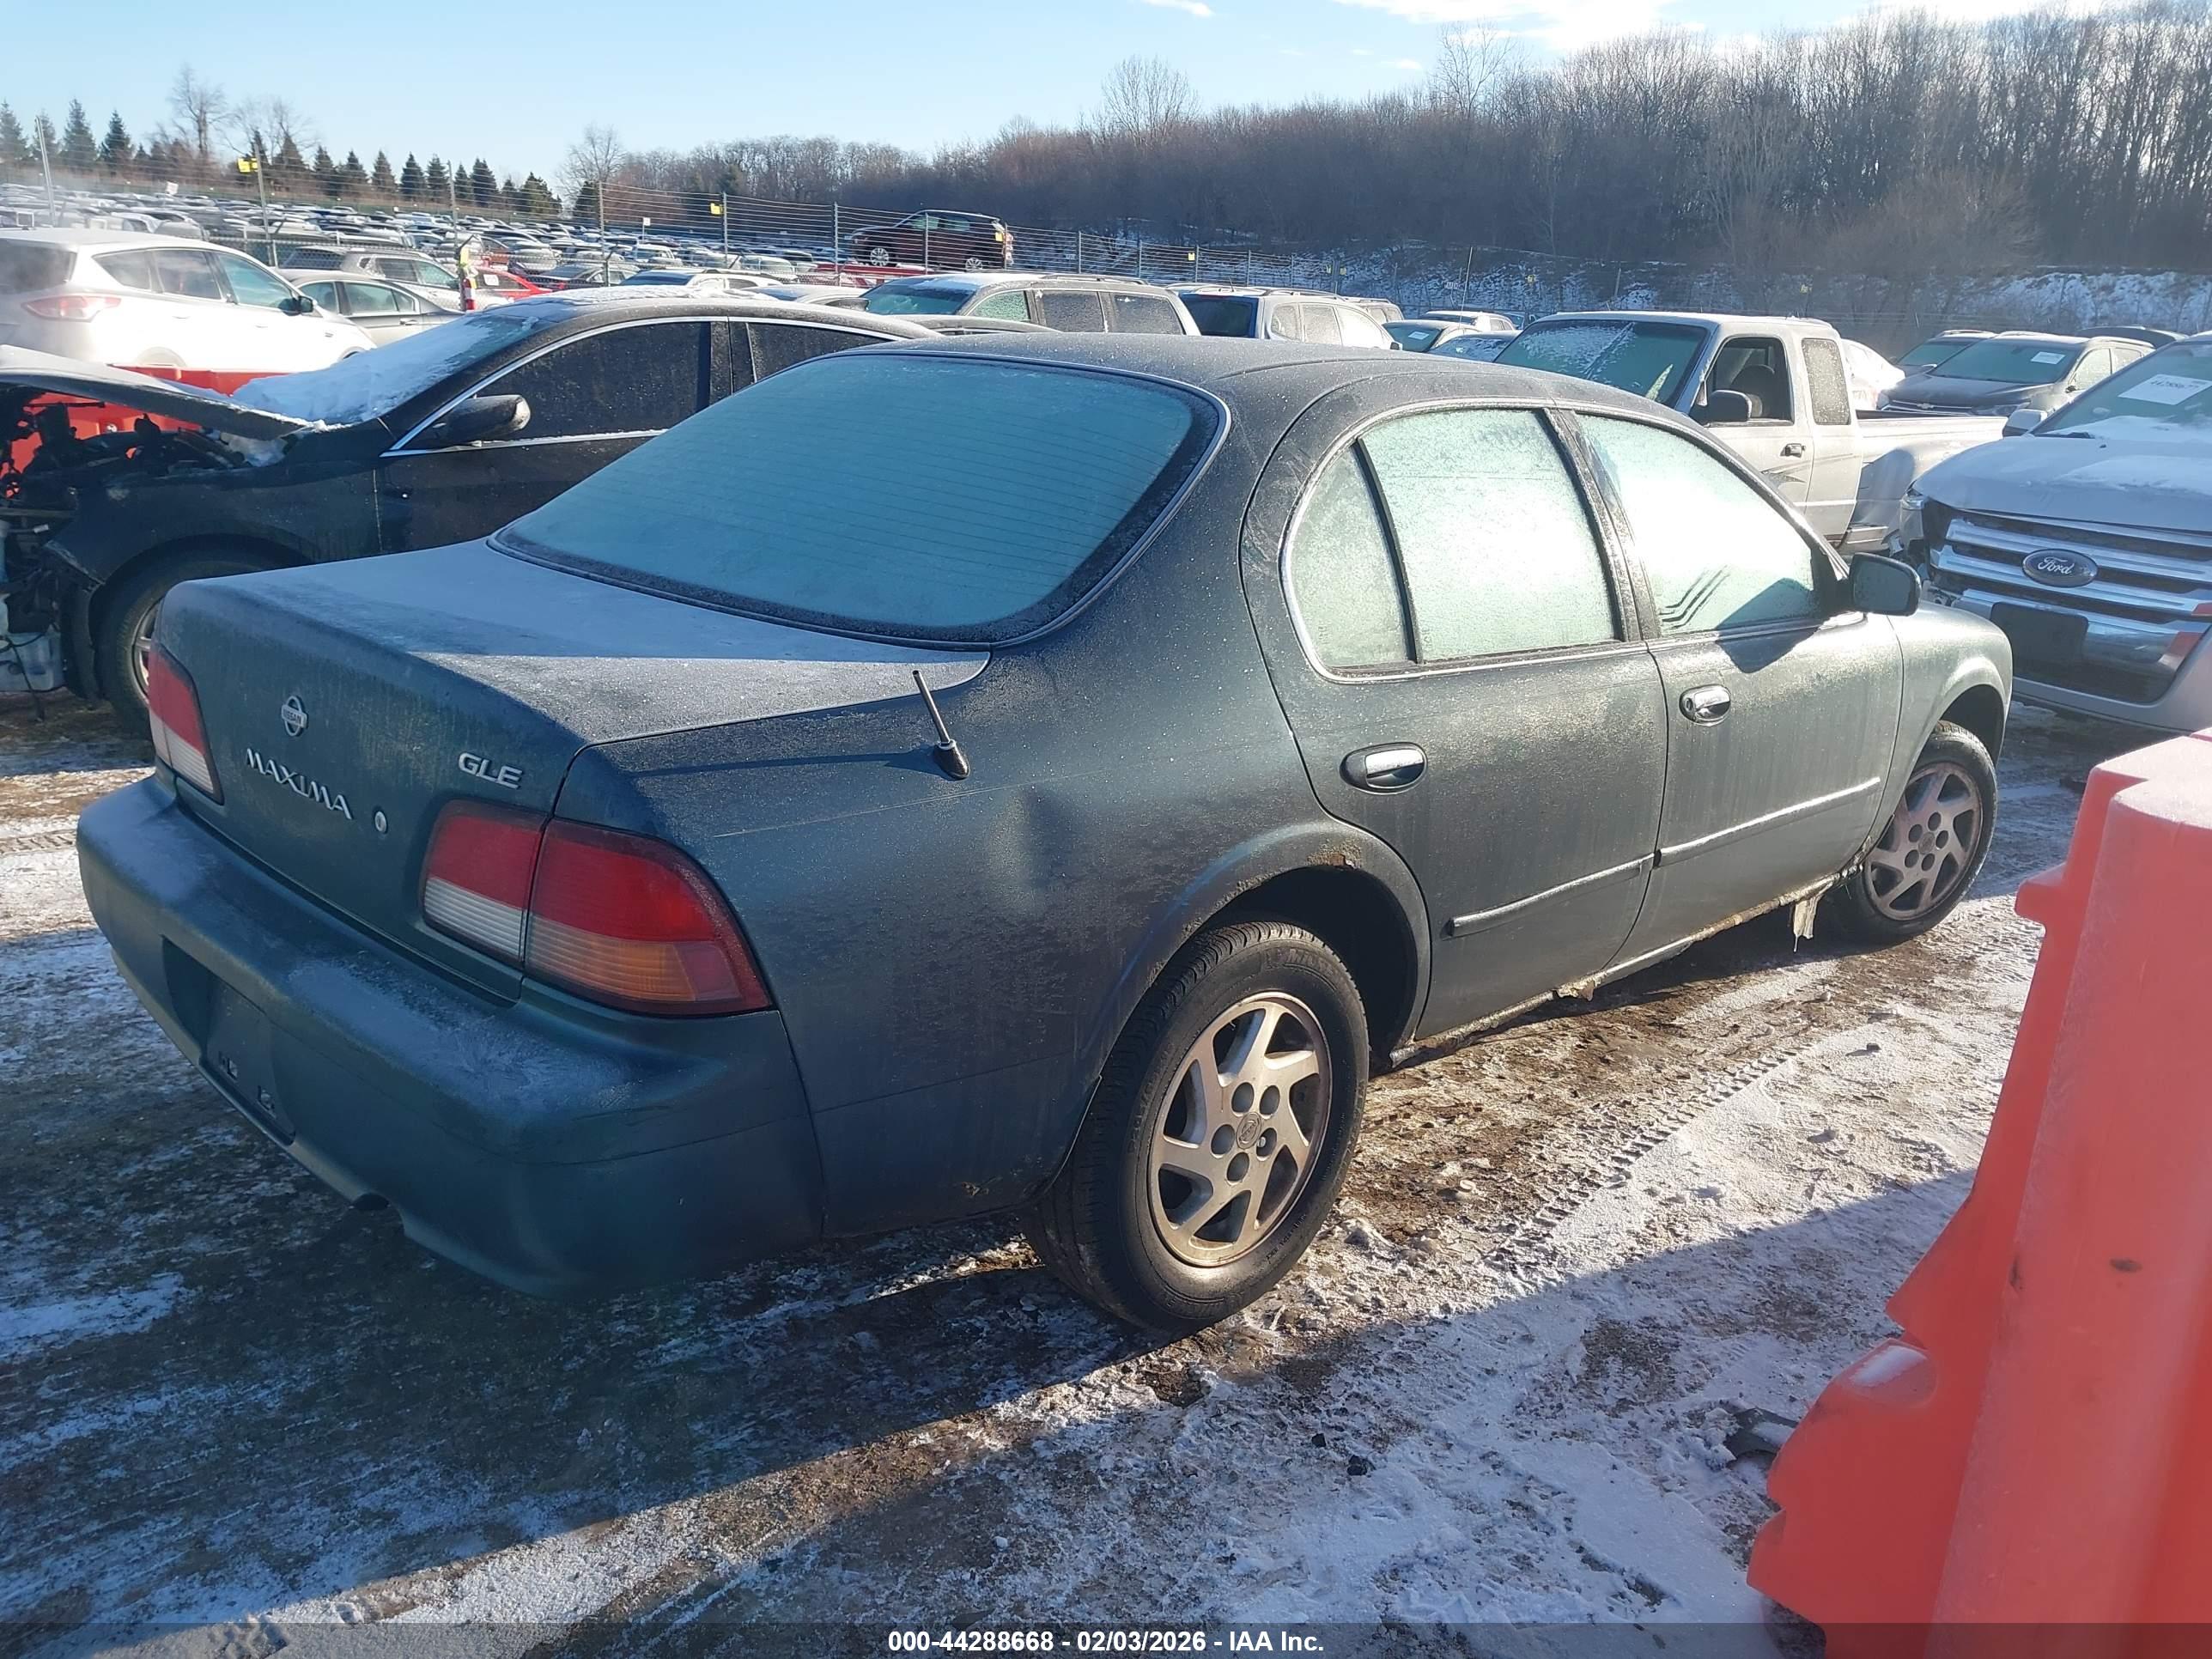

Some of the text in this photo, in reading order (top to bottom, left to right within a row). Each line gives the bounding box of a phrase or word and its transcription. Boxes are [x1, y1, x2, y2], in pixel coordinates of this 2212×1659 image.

[2038, 556, 2075, 574] Ford
[246, 748, 352, 820] MAXIMA
[459, 752, 523, 789] GLE
